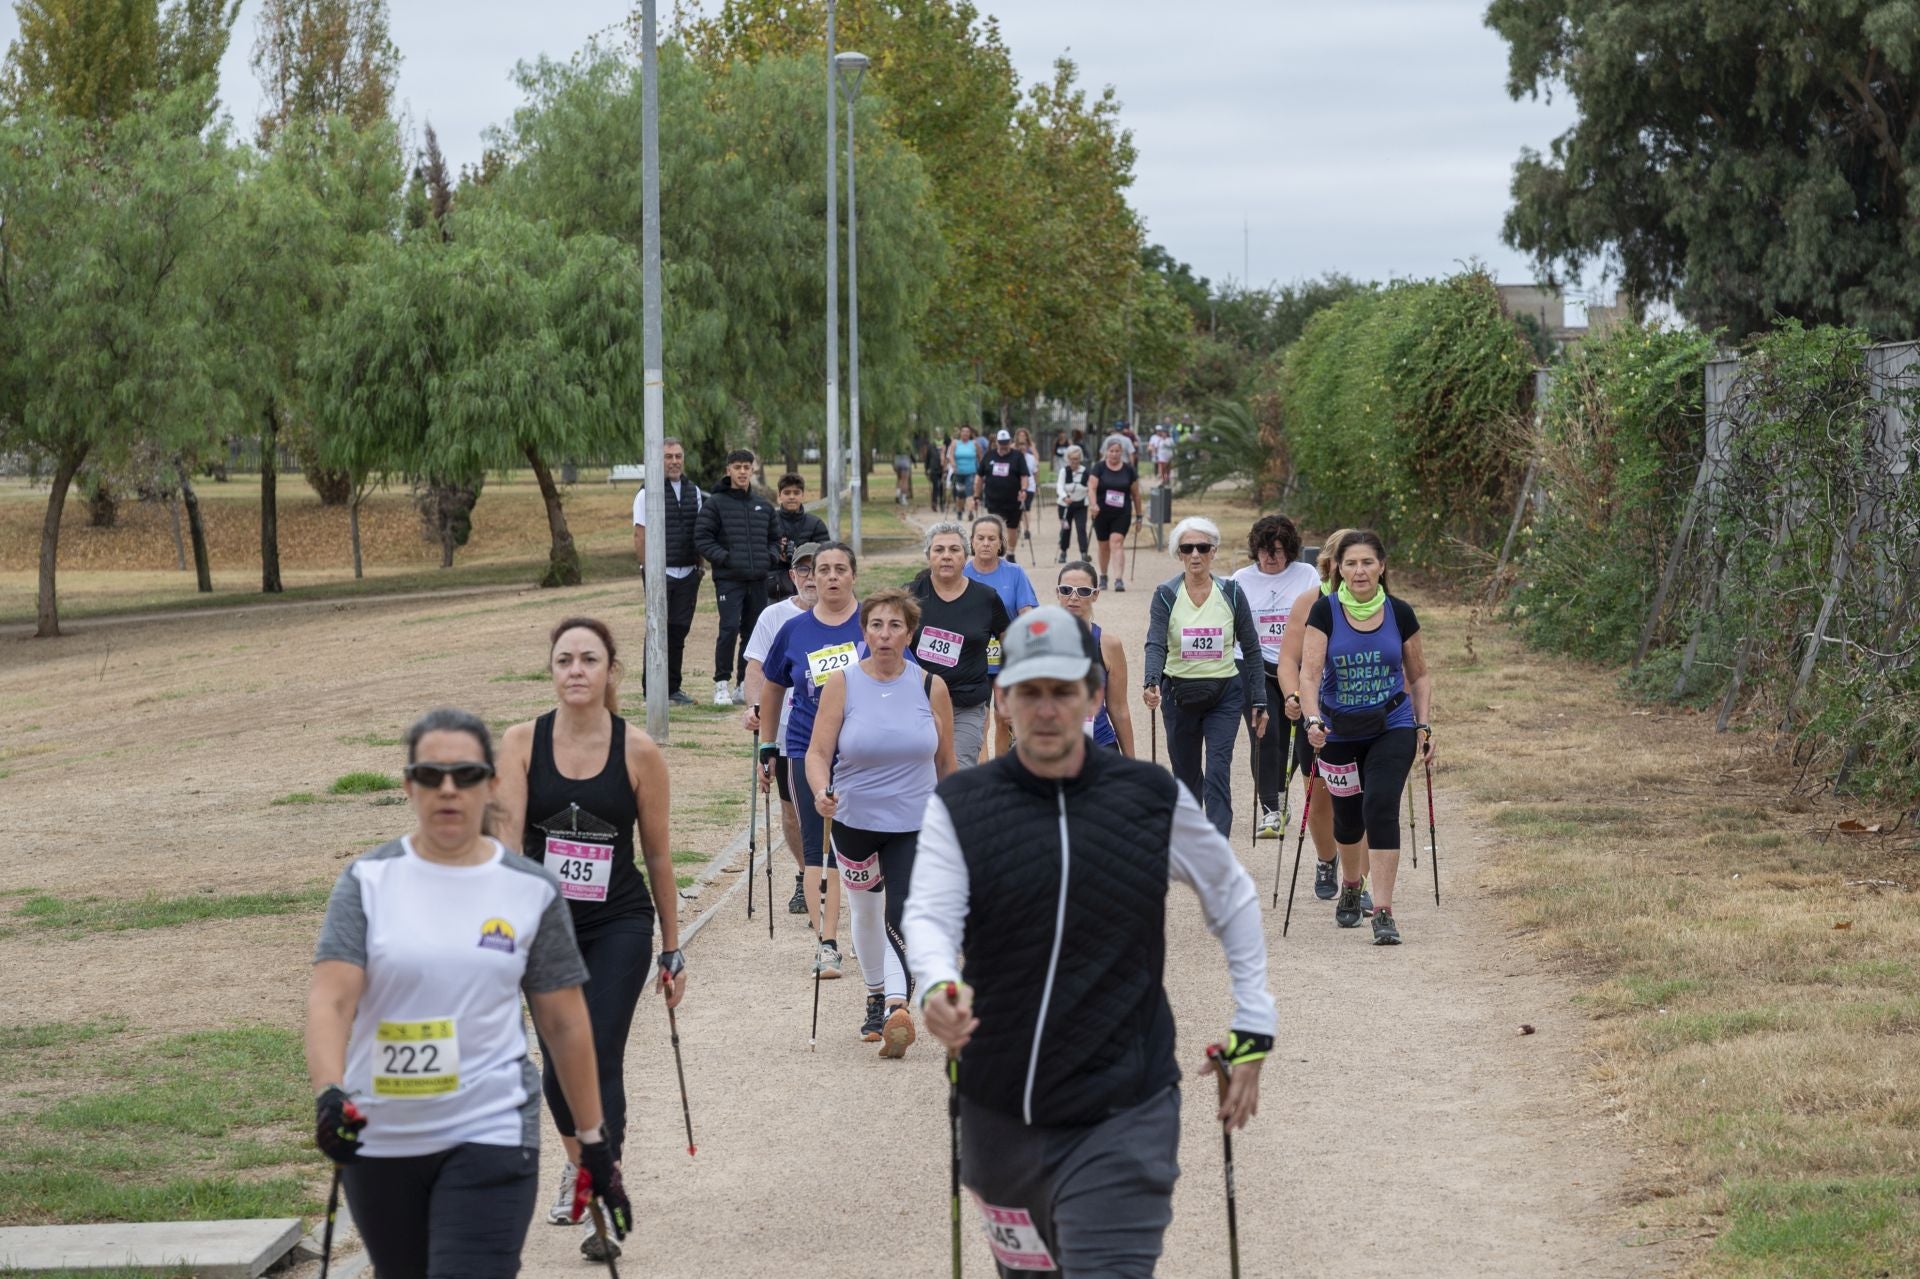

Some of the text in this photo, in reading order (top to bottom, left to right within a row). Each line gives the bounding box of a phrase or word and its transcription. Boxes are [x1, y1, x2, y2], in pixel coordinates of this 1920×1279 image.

[929, 639, 950, 654] 438
[1192, 637, 1213, 649] 432
[818, 653, 849, 672] 229
[1347, 650, 1381, 665] LOVE
[1349, 665, 1390, 679] DREAM
[1347, 691, 1390, 705] REPEAT
[1327, 774, 1348, 787] 444
[560, 859, 593, 882] 435
[845, 869, 869, 882] 428
[384, 1045, 441, 1074] 222
[986, 1223, 1021, 1249] 45
